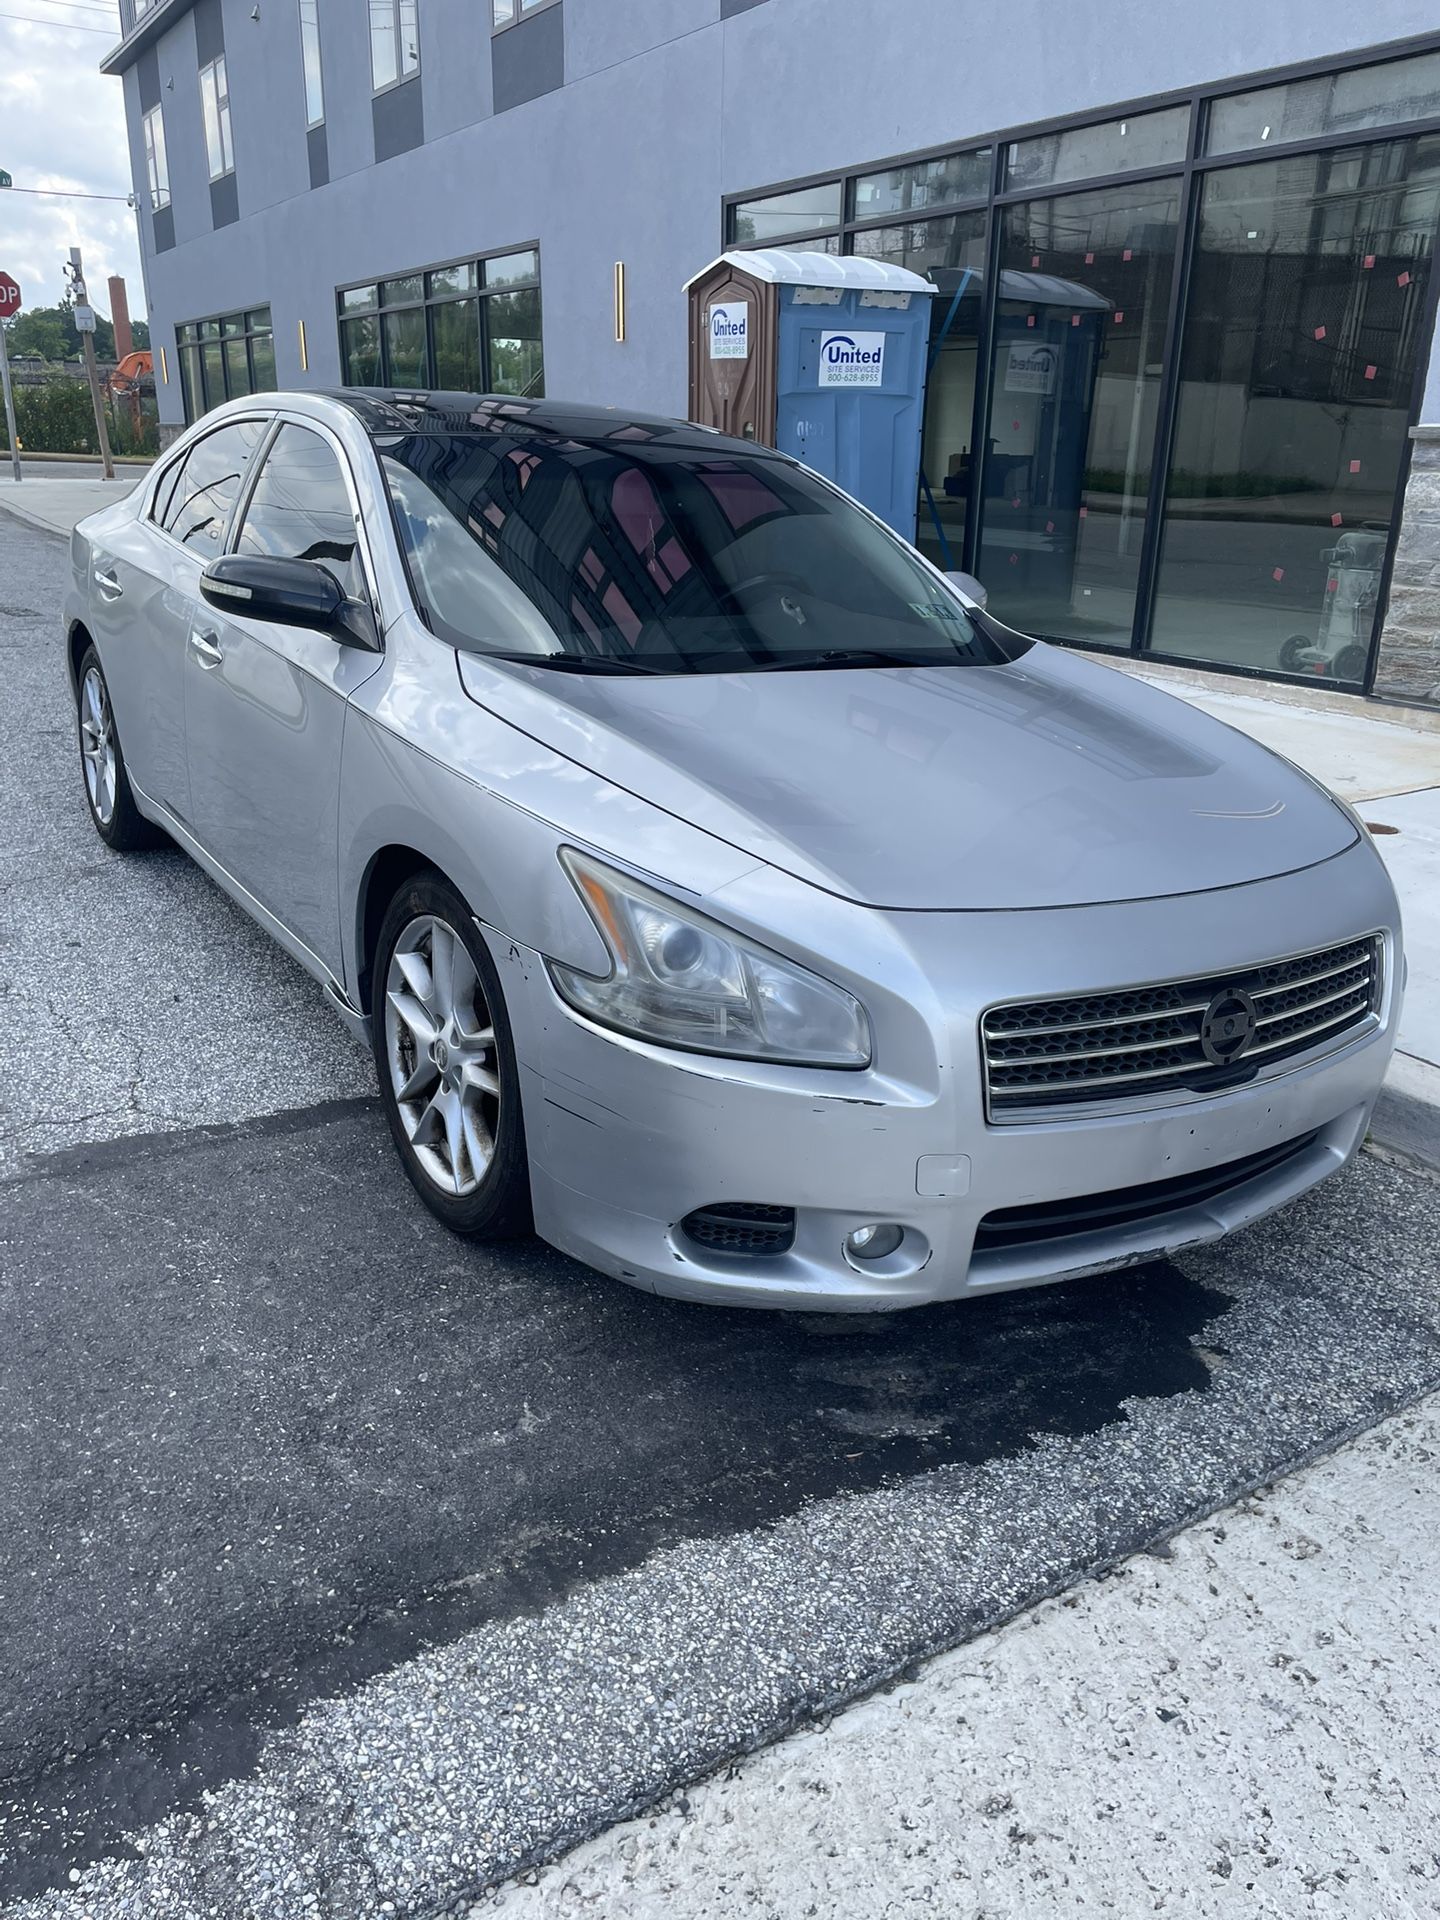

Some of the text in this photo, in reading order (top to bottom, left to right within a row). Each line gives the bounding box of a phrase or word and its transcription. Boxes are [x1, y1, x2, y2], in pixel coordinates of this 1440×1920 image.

[713, 318, 746, 336] United
[828, 346, 881, 363] United
[827, 365, 880, 373] SITE SERVICES
[827, 373, 879, 382] 800-628-8955
